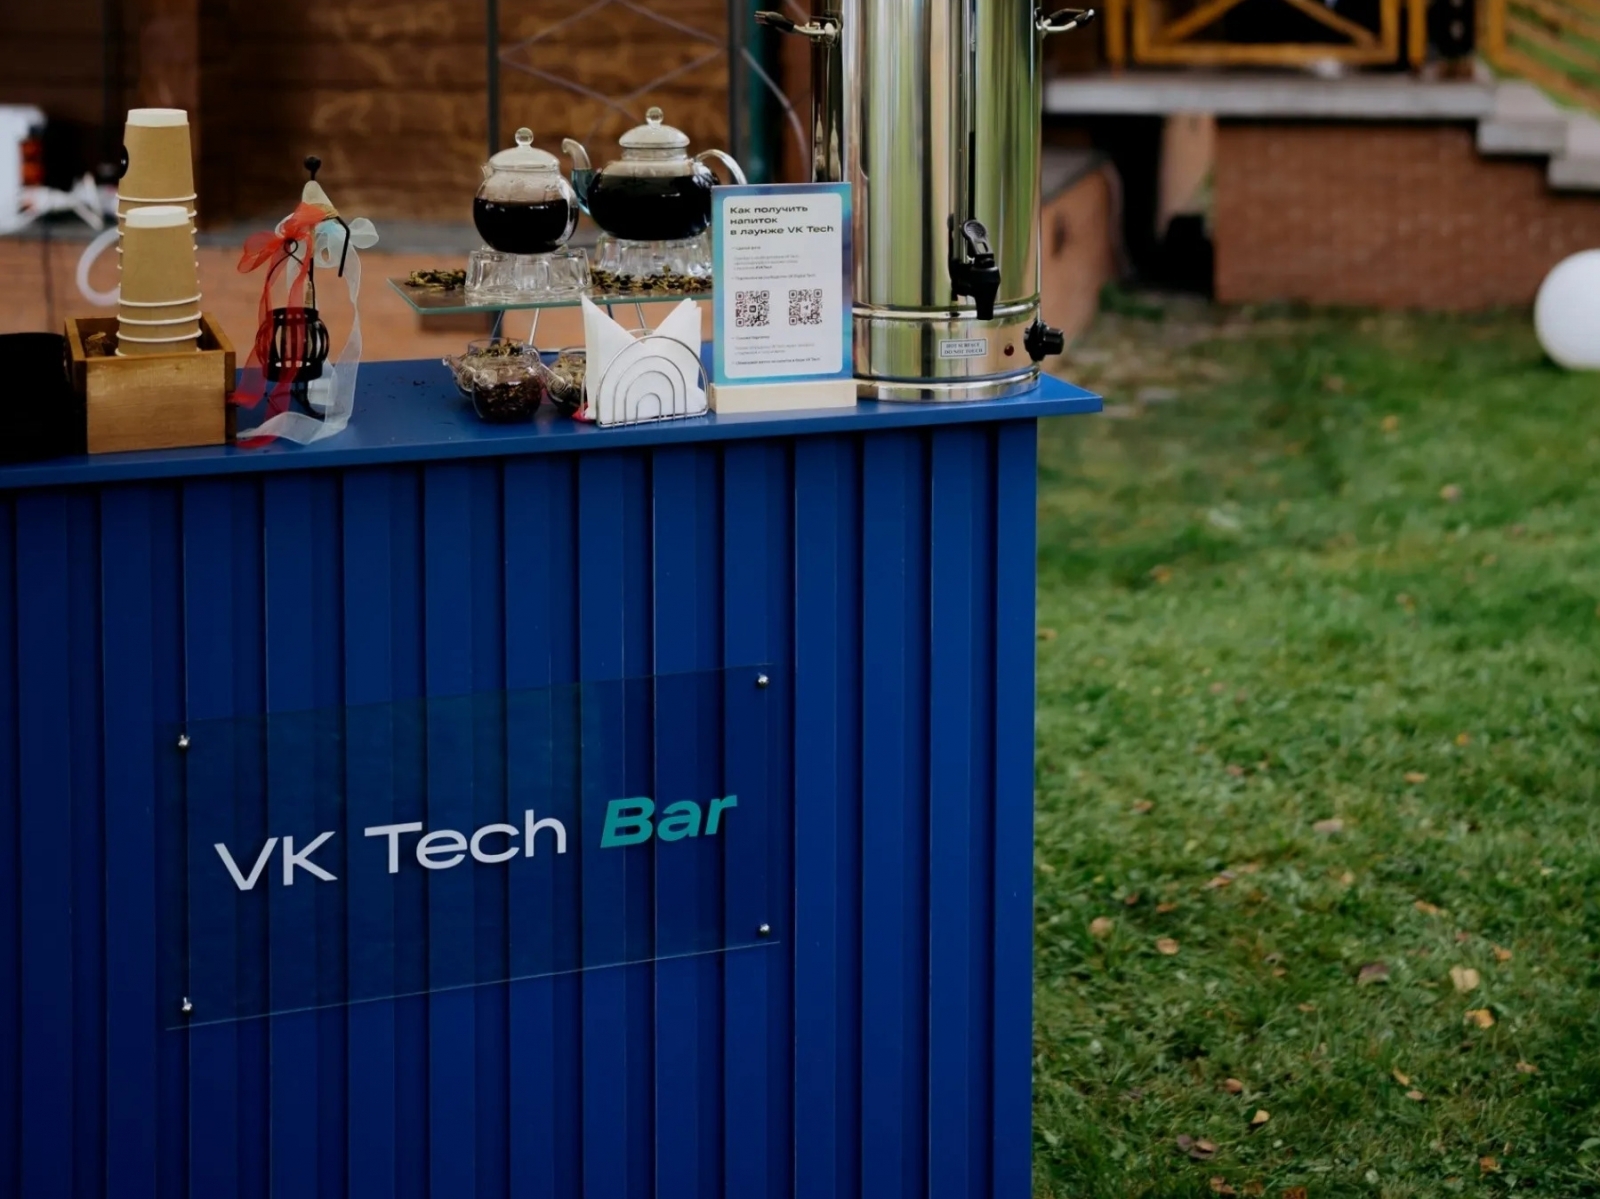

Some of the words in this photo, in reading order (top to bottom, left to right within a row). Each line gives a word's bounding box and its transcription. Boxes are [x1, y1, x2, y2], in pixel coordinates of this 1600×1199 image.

[730, 206, 751, 214] Как
[754, 205, 809, 215] получить
[730, 217, 778, 225] напиток
[740, 226, 785, 237] лаунже
[787, 226, 804, 234] VK
[806, 225, 834, 233] Tech
[213, 831, 338, 892] VK
[364, 808, 567, 875] Tech
[599, 795, 738, 849] Bar
